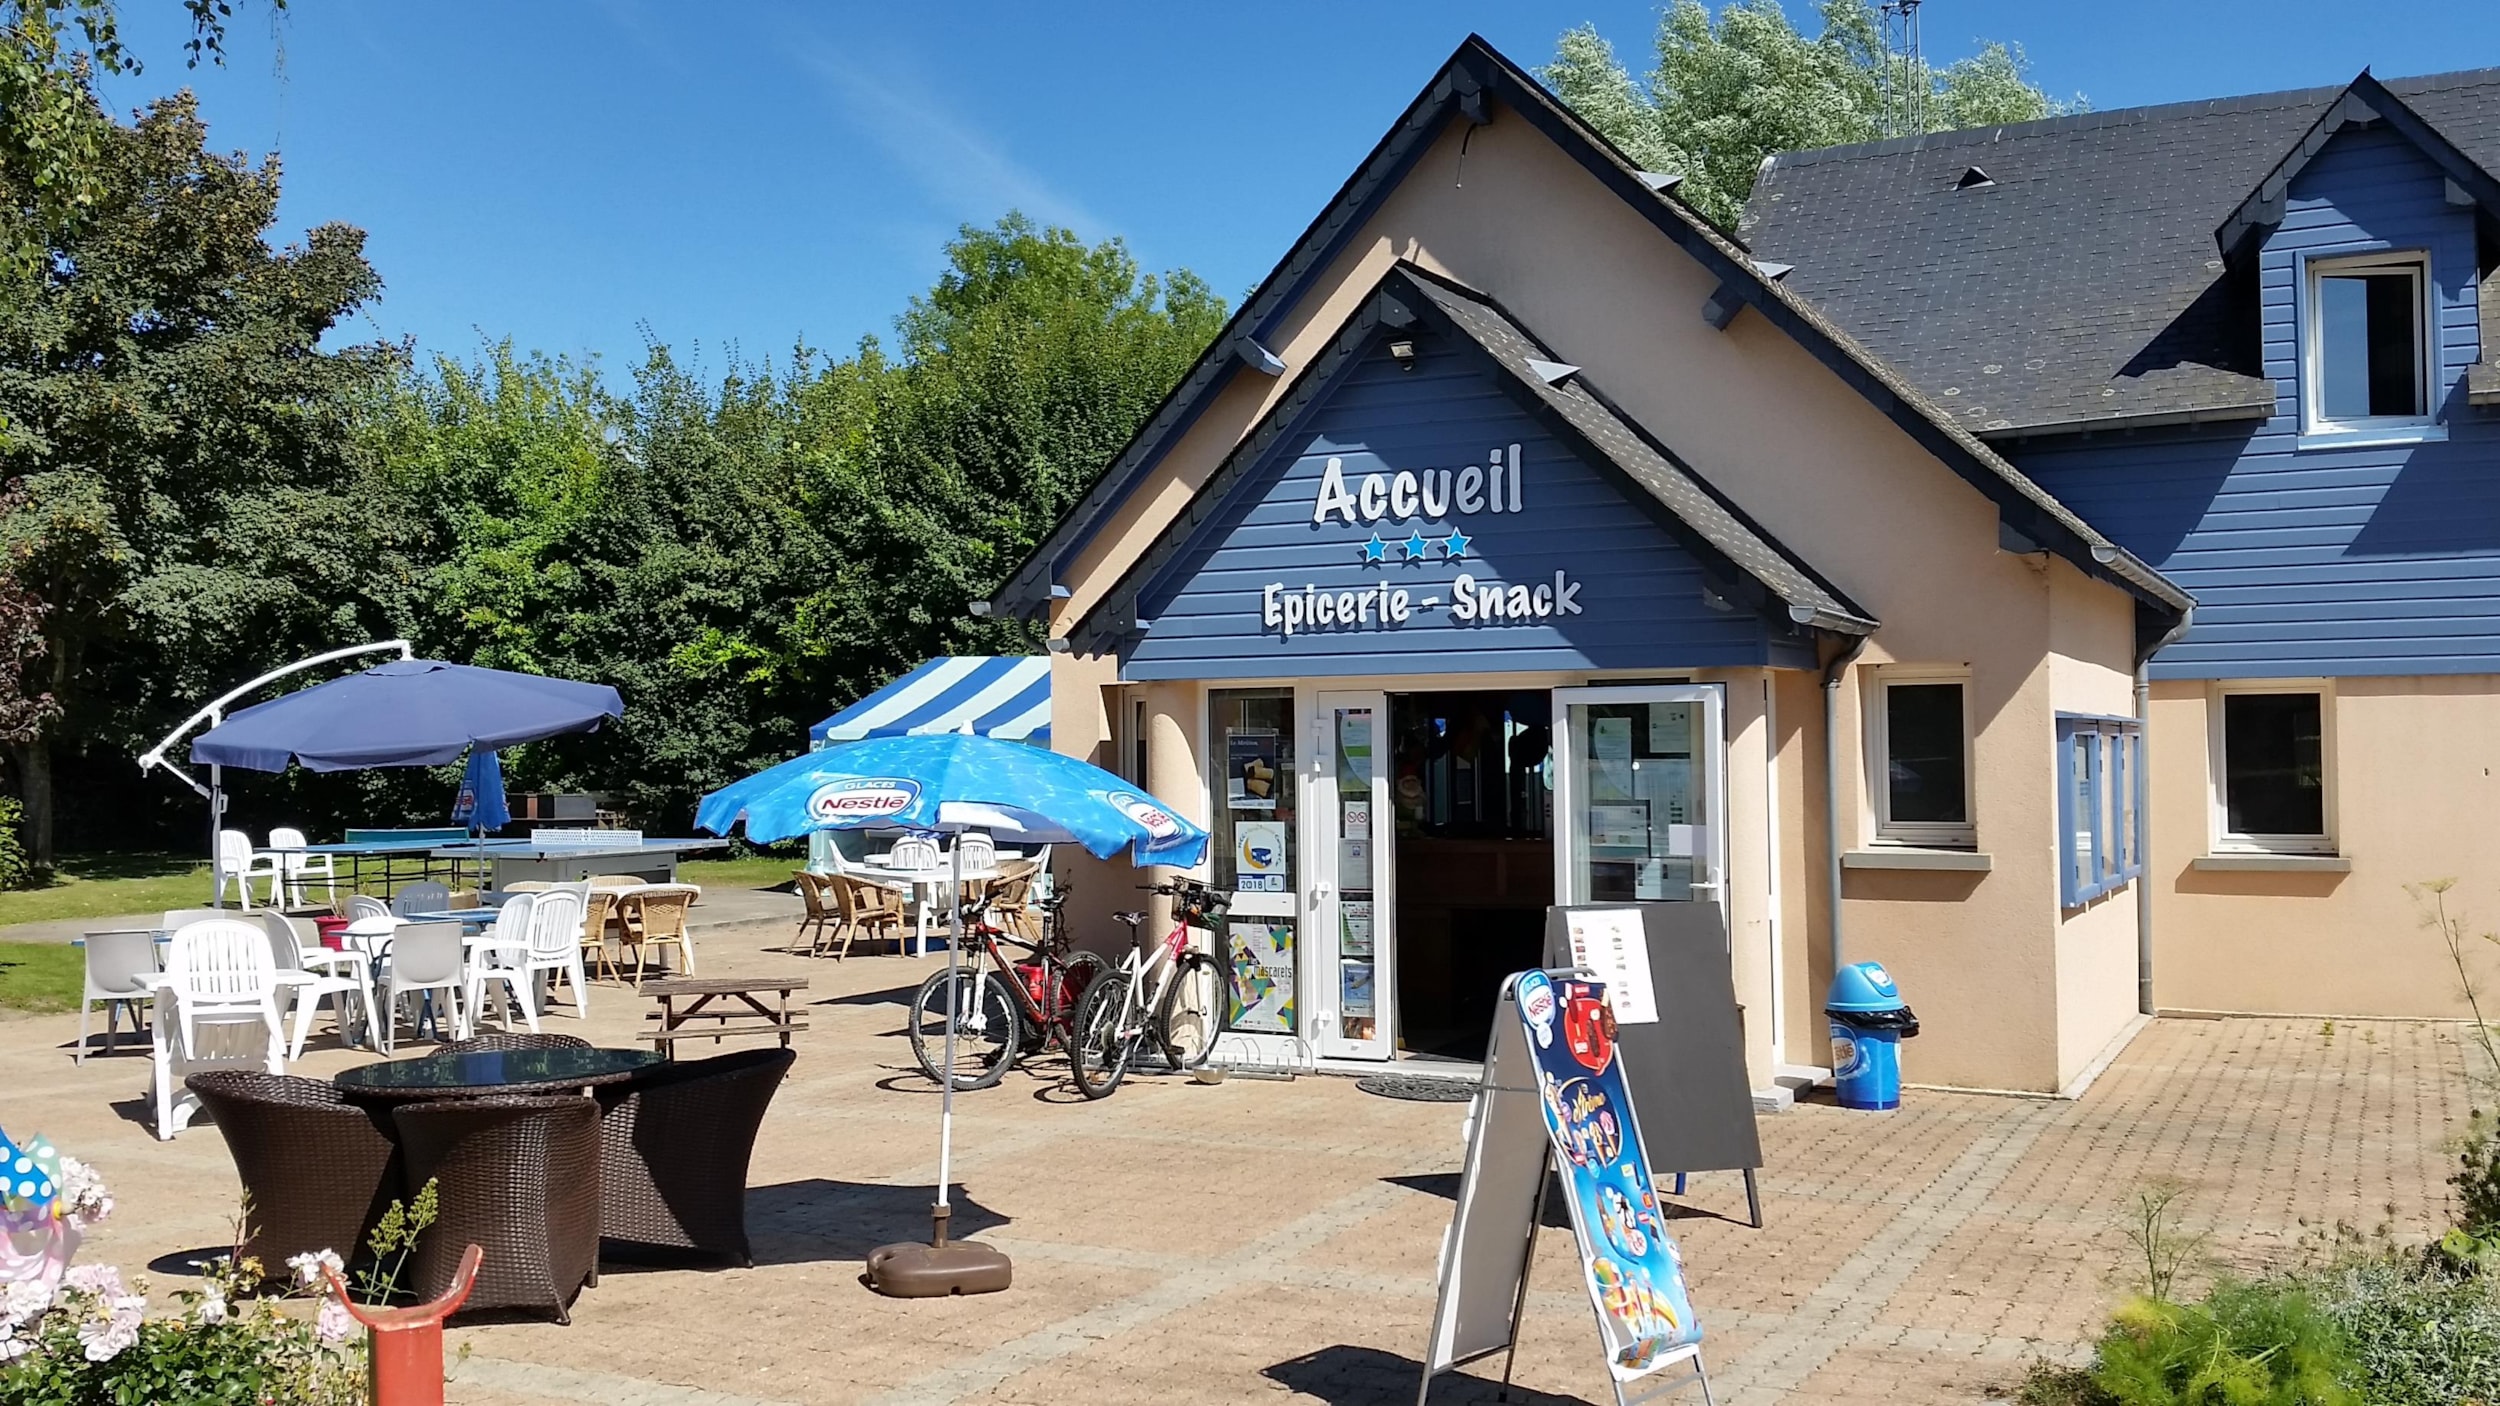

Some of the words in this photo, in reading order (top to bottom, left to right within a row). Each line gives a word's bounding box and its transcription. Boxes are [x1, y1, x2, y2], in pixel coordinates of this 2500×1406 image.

[1313, 443, 1523, 524] Accueil
[1264, 580, 1410, 635] Epicerie
[1452, 569, 1583, 619] Snack
[844, 781, 896, 790] GLACES
[821, 796, 907, 810] Nestlé
[1240, 880, 1263, 889] 2018
